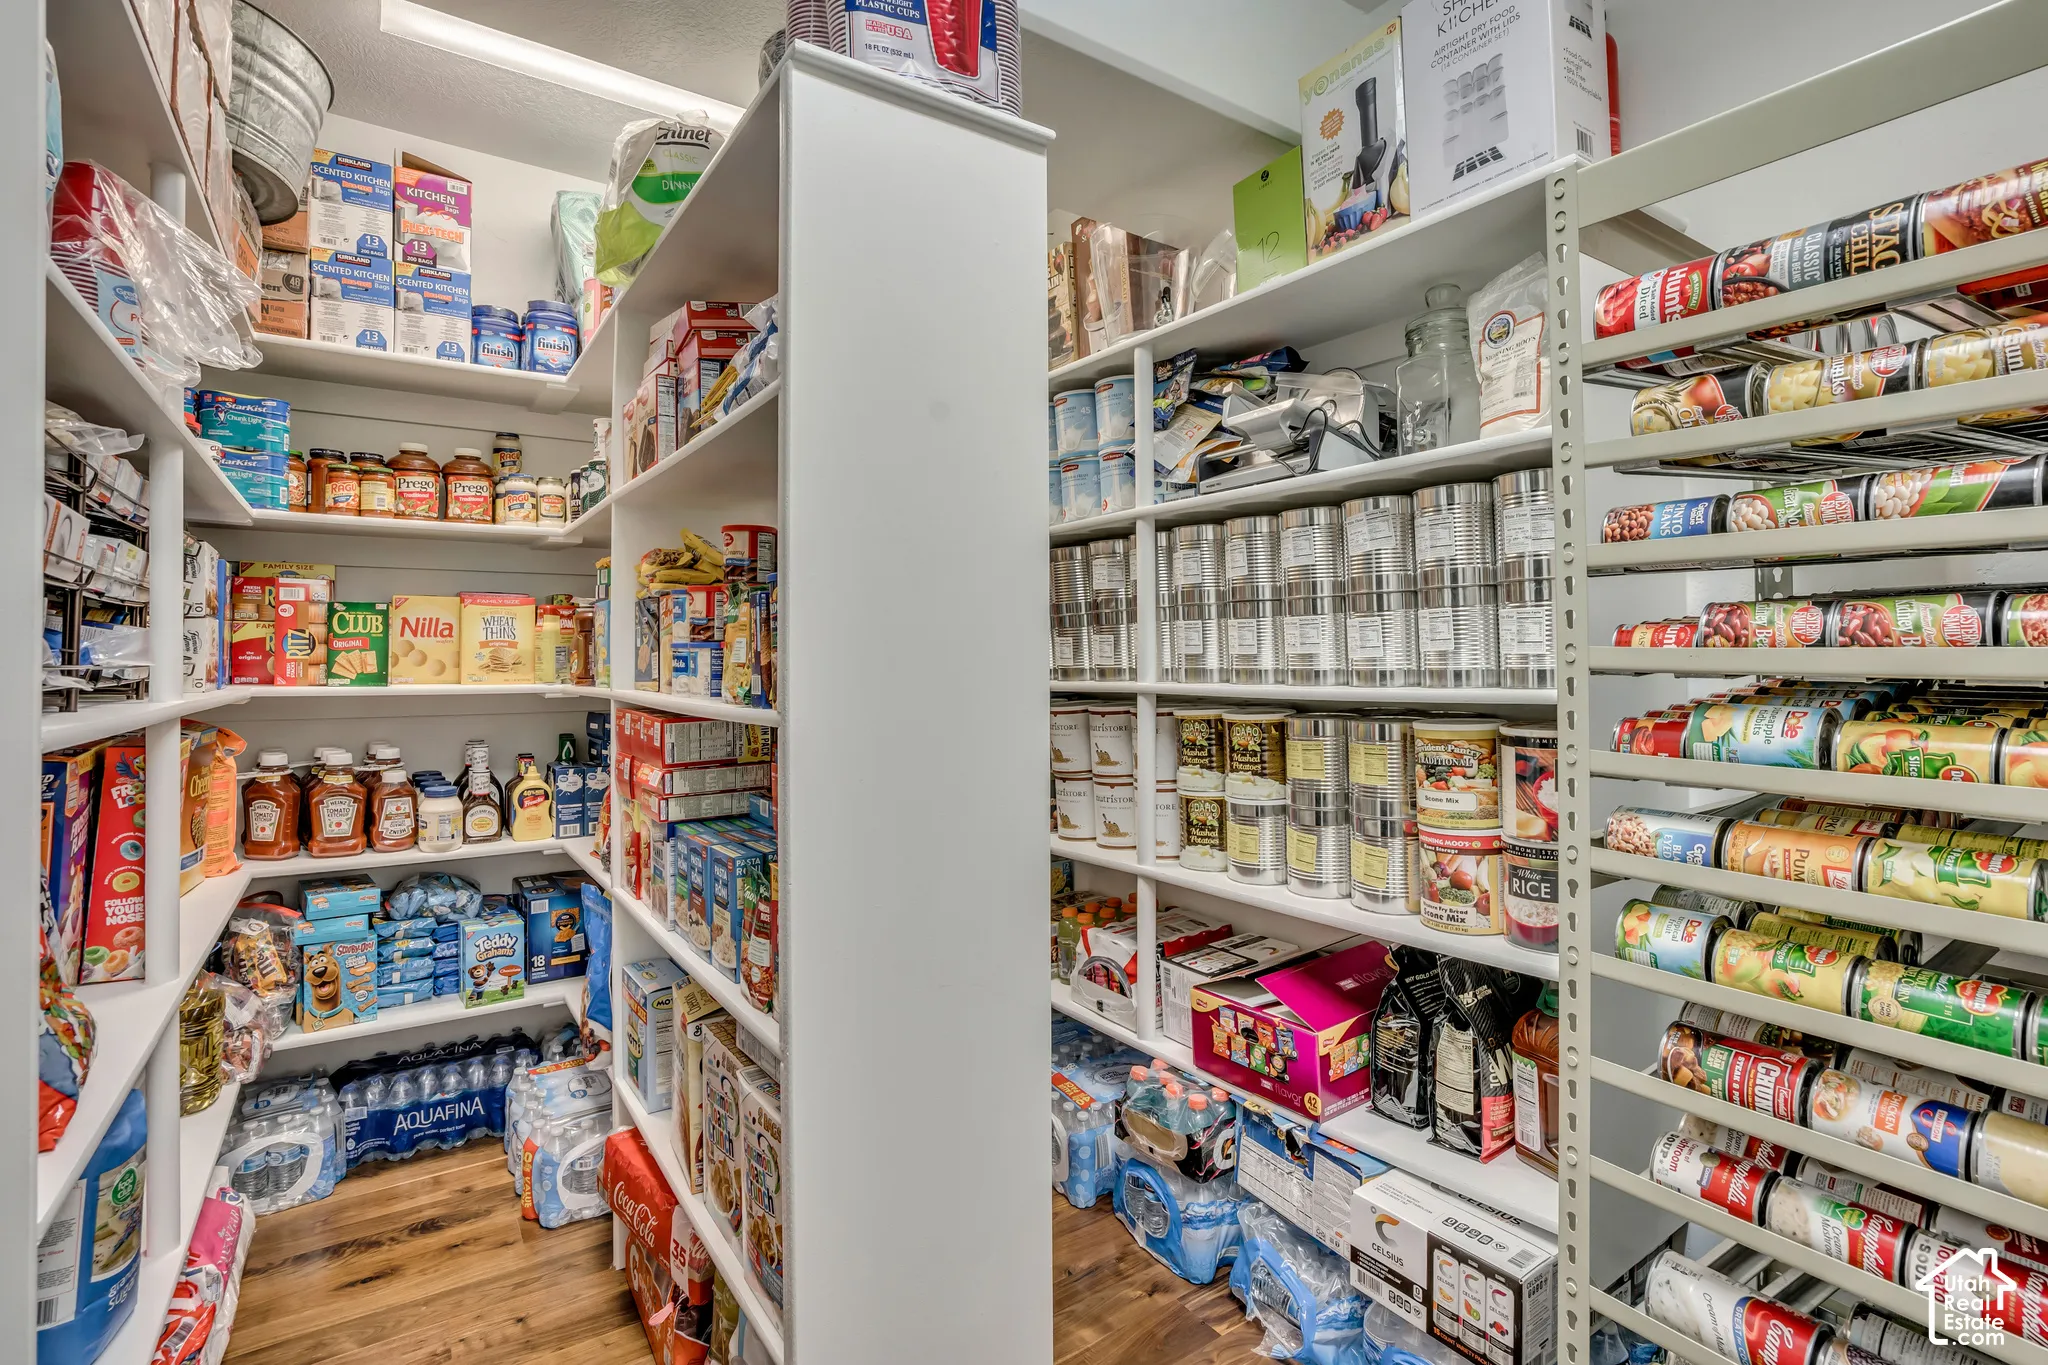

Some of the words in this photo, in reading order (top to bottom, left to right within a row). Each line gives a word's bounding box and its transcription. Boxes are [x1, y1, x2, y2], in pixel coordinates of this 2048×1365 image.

[855, 0, 895, 14] PLASTIC
[897, 6, 920, 19] CUPS
[887, 23, 912, 40] USA
[1433, 32, 1469, 57] AIRTIGHT
[1471, 22, 1487, 35] DRY
[1489, 5, 1515, 26] FOOD
[881, 45, 889, 53] OZ
[1431, 38, 1477, 69] CONTAINER
[1479, 24, 1501, 41] WITH
[1503, 13, 1520, 29] LIDS
[1451, 41, 1488, 66] CONTAINER
[1490, 28, 1510, 44] SET)
[1303, 37, 1386, 105] yonanas
[337, 156, 372, 170] KIRKLAND
[662, 148, 698, 165] CLASSIC
[313, 164, 352, 179] SCENTED
[354, 173, 391, 188] KITCHEN
[375, 187, 391, 197] Bags
[406, 186, 456, 205] KITCHEN
[444, 205, 460, 215] Bags
[365, 235, 379, 247] 13
[411, 239, 428, 252] 13
[1257, 231, 1281, 264] 12
[336, 253, 371, 266] KIRKLAND
[406, 256, 418, 264] 200
[418, 257, 434, 266] BAGS
[1804, 232, 1821, 282] CLASSIC
[290, 275, 301, 286] 48
[312, 262, 352, 277] SCENTED
[353, 269, 391, 283] KITCHEN
[419, 267, 452, 280] KIRKLAND
[1792, 261, 1803, 284] BEANS
[374, 282, 391, 292] Bags
[397, 276, 434, 291] SCENTED
[435, 283, 469, 297] KITCHEN
[454, 296, 469, 305] Bags
[1638, 286, 1651, 320] Diced
[1688, 283, 1701, 309] NATURAL
[1649, 301, 1657, 322] Added
[365, 330, 379, 342] 13
[445, 342, 458, 353] 13
[482, 342, 514, 359] finish
[537, 336, 570, 353] finish
[225, 401, 268, 413] StarKist
[227, 414, 247, 423] Chunk
[247, 416, 262, 424] Light
[398, 477, 435, 492] Prego
[453, 482, 489, 496] Prego
[1784, 487, 1799, 510] Great
[1660, 504, 1673, 536] BEANS
[1671, 502, 1688, 535] PINTO
[1689, 508, 1697, 526] Value
[1696, 502, 1709, 525] Great
[332, 611, 384, 635] CLUB
[400, 616, 454, 638] Nilla
[482, 615, 516, 627] WHEAT
[483, 626, 516, 641] THINS
[287, 629, 310, 660] RITZ
[333, 639, 363, 648] ORIGINAL
[1181, 723, 1207, 734] IDAHO
[1752, 709, 1769, 736] tidbits
[1784, 710, 1809, 739] Dole
[1232, 726, 1259, 738] IDAHO
[760, 738, 770, 757] PACK
[1182, 748, 1208, 757] Mashed
[1449, 744, 1482, 759] Pantry
[1182, 755, 1209, 765] Potatoes
[1232, 753, 1261, 763] Mashed
[1232, 761, 1262, 771] Potatoes
[1418, 755, 1474, 768] TRADITIONAL
[1191, 802, 1218, 813] IDAHO
[1424, 795, 1444, 804] Scone
[1189, 835, 1219, 845] Potatoes
[1191, 827, 1218, 837] Mashed
[1435, 845, 1458, 854] Storage
[1444, 839, 1470, 849] MOO'S
[690, 854, 702, 868] PASTA
[1944, 851, 1961, 872] Pears
[691, 871, 703, 886] RONI
[714, 865, 728, 880] PASTA
[1517, 867, 1542, 880] White
[715, 883, 728, 900] RONI
[1512, 879, 1551, 899] RICE
[104, 895, 144, 908] FOLLOW
[105, 906, 145, 916] YOUR
[1424, 907, 1445, 922] Scone
[1446, 910, 1467, 924] Mix
[1438, 905, 1448, 914] Fry
[1449, 907, 1468, 916] Bread
[105, 913, 145, 926] NOSE
[1664, 918, 1674, 935] fruit
[1670, 915, 1686, 943] tropical
[1680, 918, 1703, 944] Dole
[475, 933, 518, 953] Teddy
[476, 948, 516, 962] Grahams
[531, 955, 546, 967] 18
[1405, 975, 1415, 984] WHY
[1415, 972, 1425, 980] GOLD
[1897, 977, 1911, 1004] CORN
[1885, 1002, 1893, 1018] NON
[397, 1042, 482, 1065] AQUAFINA
[1732, 1055, 1746, 1081] STEAK
[1307, 1097, 1318, 1108] 42
[393, 1096, 485, 1136] AQUAFINA
[757, 1107, 764, 1121] 2
[1884, 1093, 1904, 1132] CHICKEN
[440, 1126, 455, 1134] perfect
[1932, 1109, 1946, 1141] SWANSON
[117, 1174, 134, 1191] food
[117, 1184, 133, 1199] club
[613, 1180, 660, 1249] Coca-Cola
[671, 1238, 687, 1268] 35
[1371, 1241, 1404, 1267] CELSIUS
[1462, 1290, 1482, 1305] CELSIUS
[1702, 1291, 1718, 1329] Cream
[1734, 1306, 1744, 1334] GREAT
[1433, 1326, 1441, 1336] 15
[1440, 1331, 1456, 1346] COUNT
[1455, 1341, 1475, 1357] VARIETY
